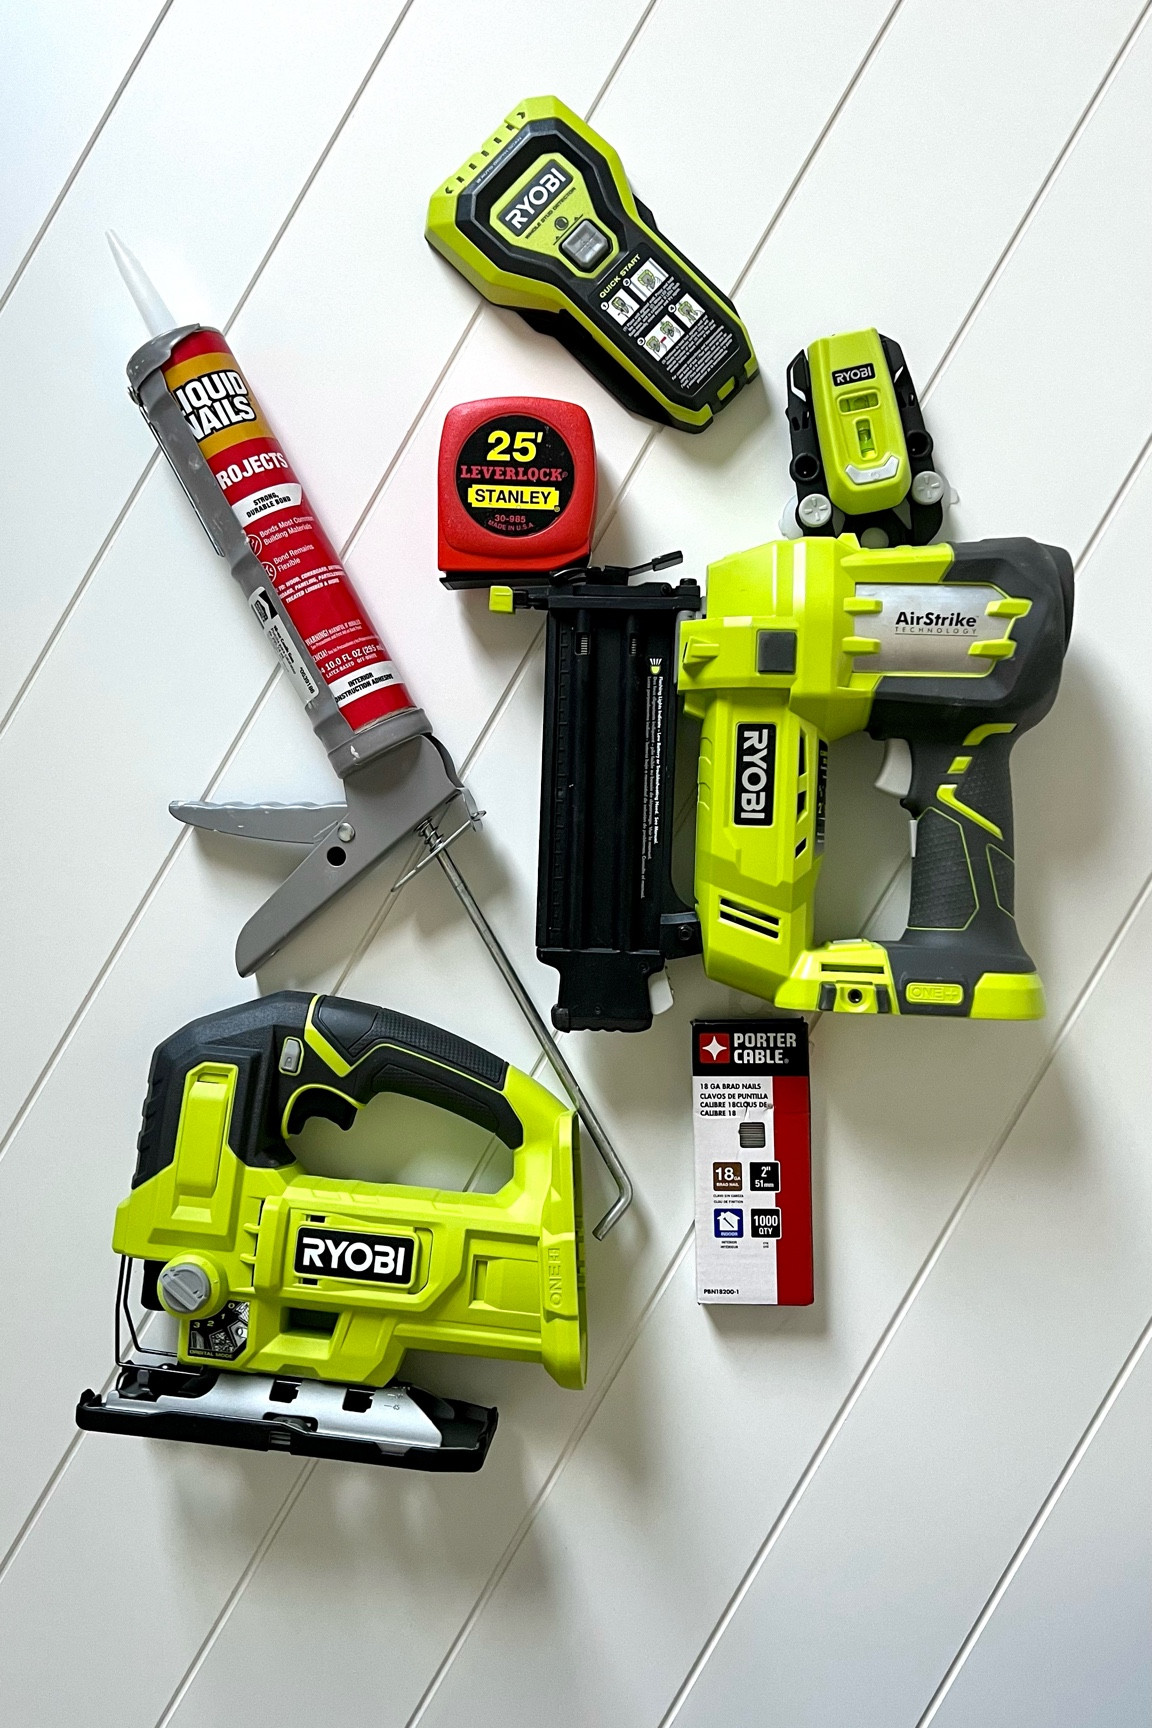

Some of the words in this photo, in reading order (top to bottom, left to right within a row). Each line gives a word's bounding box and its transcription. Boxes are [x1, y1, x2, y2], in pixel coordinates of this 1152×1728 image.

[505, 167, 567, 230] RYOBI
[552, 187, 576, 211] DETECTOR
[599, 276, 621, 299] QUICK
[619, 253, 641, 276] START
[834, 366, 872, 384] RYOBI
[176, 371, 248, 414] IQUID
[486, 430, 543, 462] 25'
[215, 452, 288, 490] ROJECTS
[460, 465, 562, 481] LEVERLOCK
[475, 488, 551, 505] STANLEY
[246, 502, 275, 518] DURABLE
[275, 495, 291, 506] BOND
[487, 519, 506, 530] MADE
[494, 514, 526, 523] 30-985
[259, 524, 279, 538] Bonds
[278, 517, 294, 530] Most
[263, 530, 288, 546] Building
[273, 552, 290, 565] Bond
[277, 557, 301, 572] Flexible
[895, 611, 977, 627] AirStrike
[325, 657, 342, 671] 10.0
[341, 653, 352, 662] FL
[351, 648, 363, 658] OZ
[347, 671, 374, 688] INTERIOR
[334, 682, 372, 703] ONSTRUCTION
[740, 729, 769, 819] RYOBI
[911, 986, 959, 1001] ONE+
[733, 1033, 797, 1047] PORTER
[733, 1049, 784, 1064] CABLE
[715, 1167, 734, 1181] 18
[754, 1215, 778, 1227] 1000
[758, 1227, 773, 1235] QTY
[302, 1236, 406, 1276] RYOBI
[193, 1321, 200, 1329] 3
